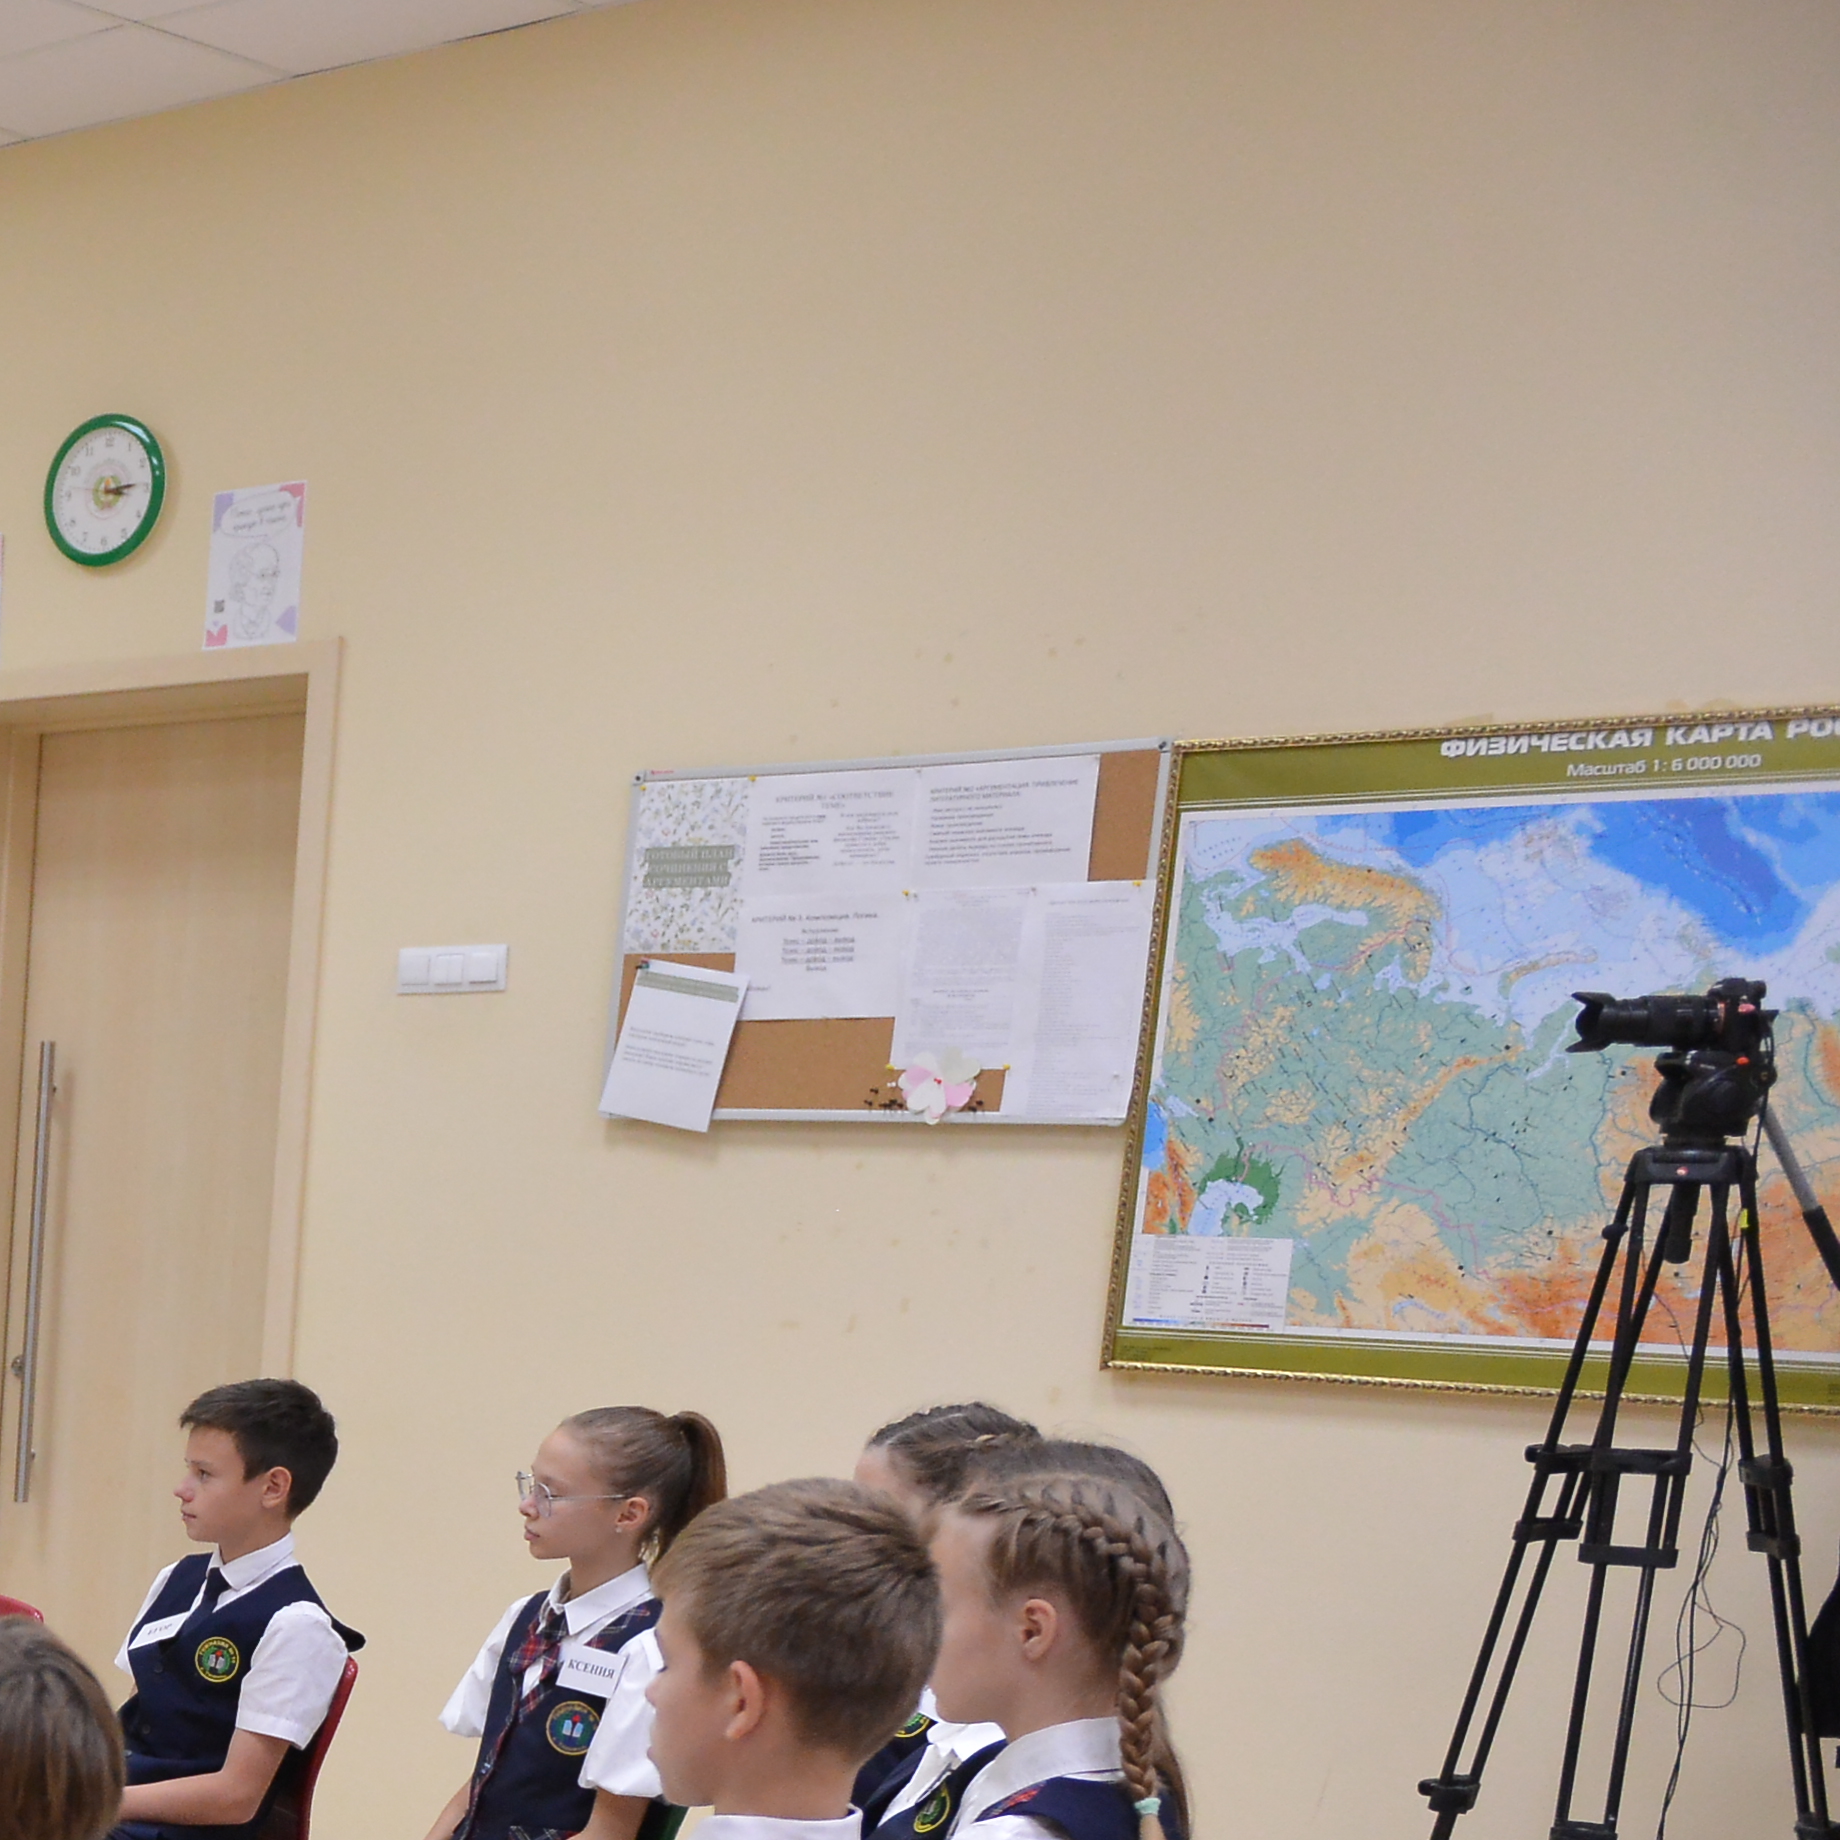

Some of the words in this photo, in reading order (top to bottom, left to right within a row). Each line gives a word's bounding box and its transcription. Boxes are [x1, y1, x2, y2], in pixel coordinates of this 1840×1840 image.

[1440, 727, 1654, 759] ФИЗИЧЕСКАЯ
[1665, 720, 1774, 746] КАРТА
[1786, 717, 1840, 739] РО
[1566, 759, 1647, 778] Масштаб
[1671, 757, 1683, 772] 6
[1686, 756, 1721, 771] 000
[1725, 753, 1762, 769] 000
[568, 1659, 615, 1679] КСЕНИЯ
